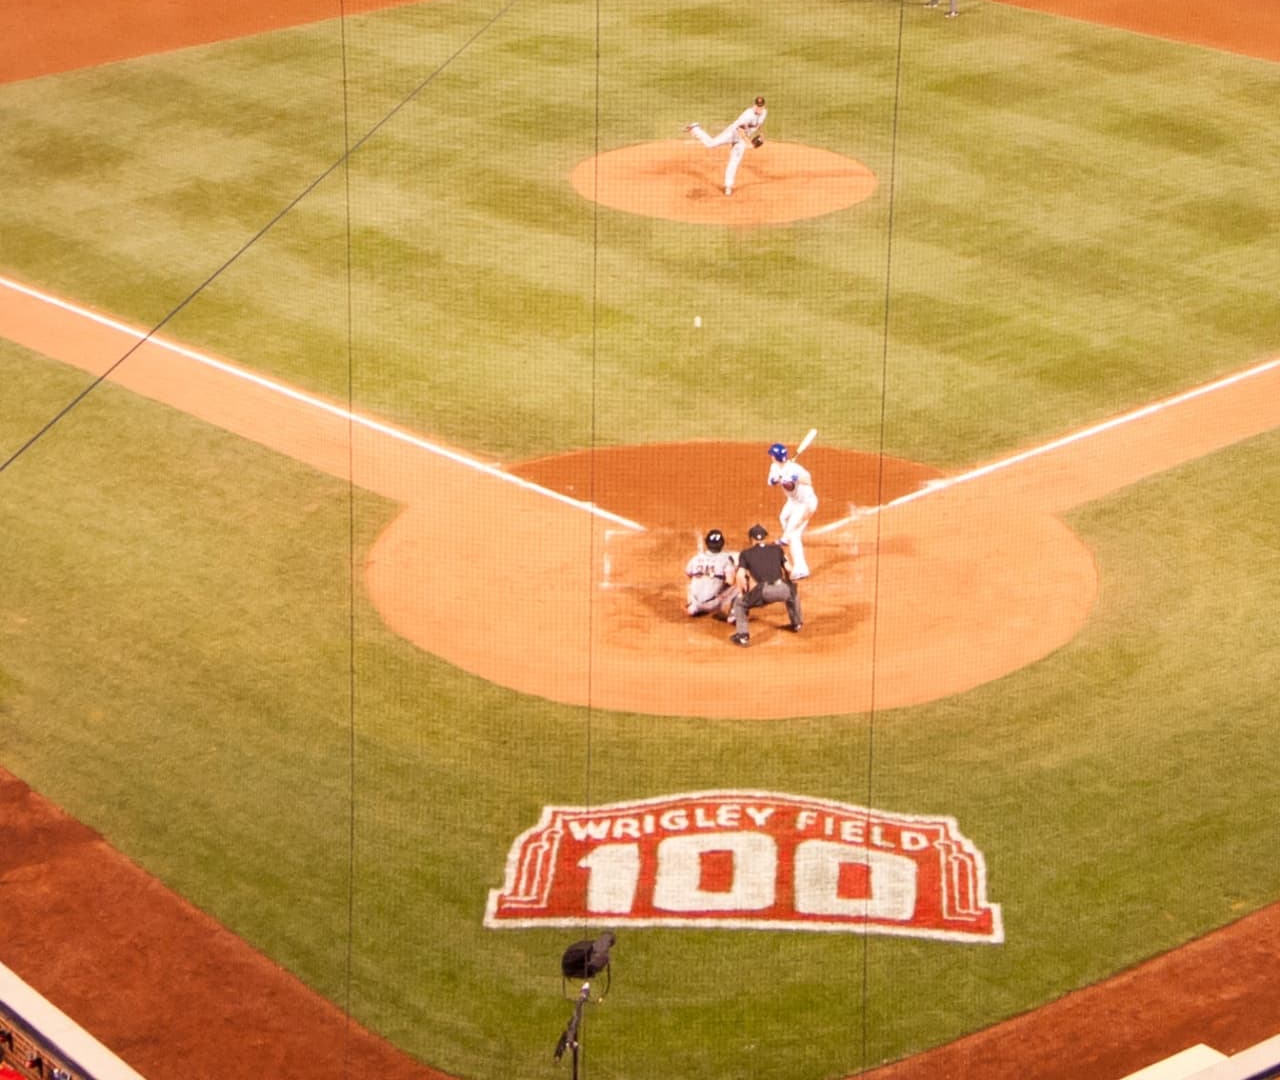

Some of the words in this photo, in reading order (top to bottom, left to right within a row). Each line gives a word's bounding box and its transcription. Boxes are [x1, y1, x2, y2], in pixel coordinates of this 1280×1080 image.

[569, 804, 777, 844] WRIGLEY
[796, 809, 929, 852] FIELD
[577, 831, 918, 921] 100
